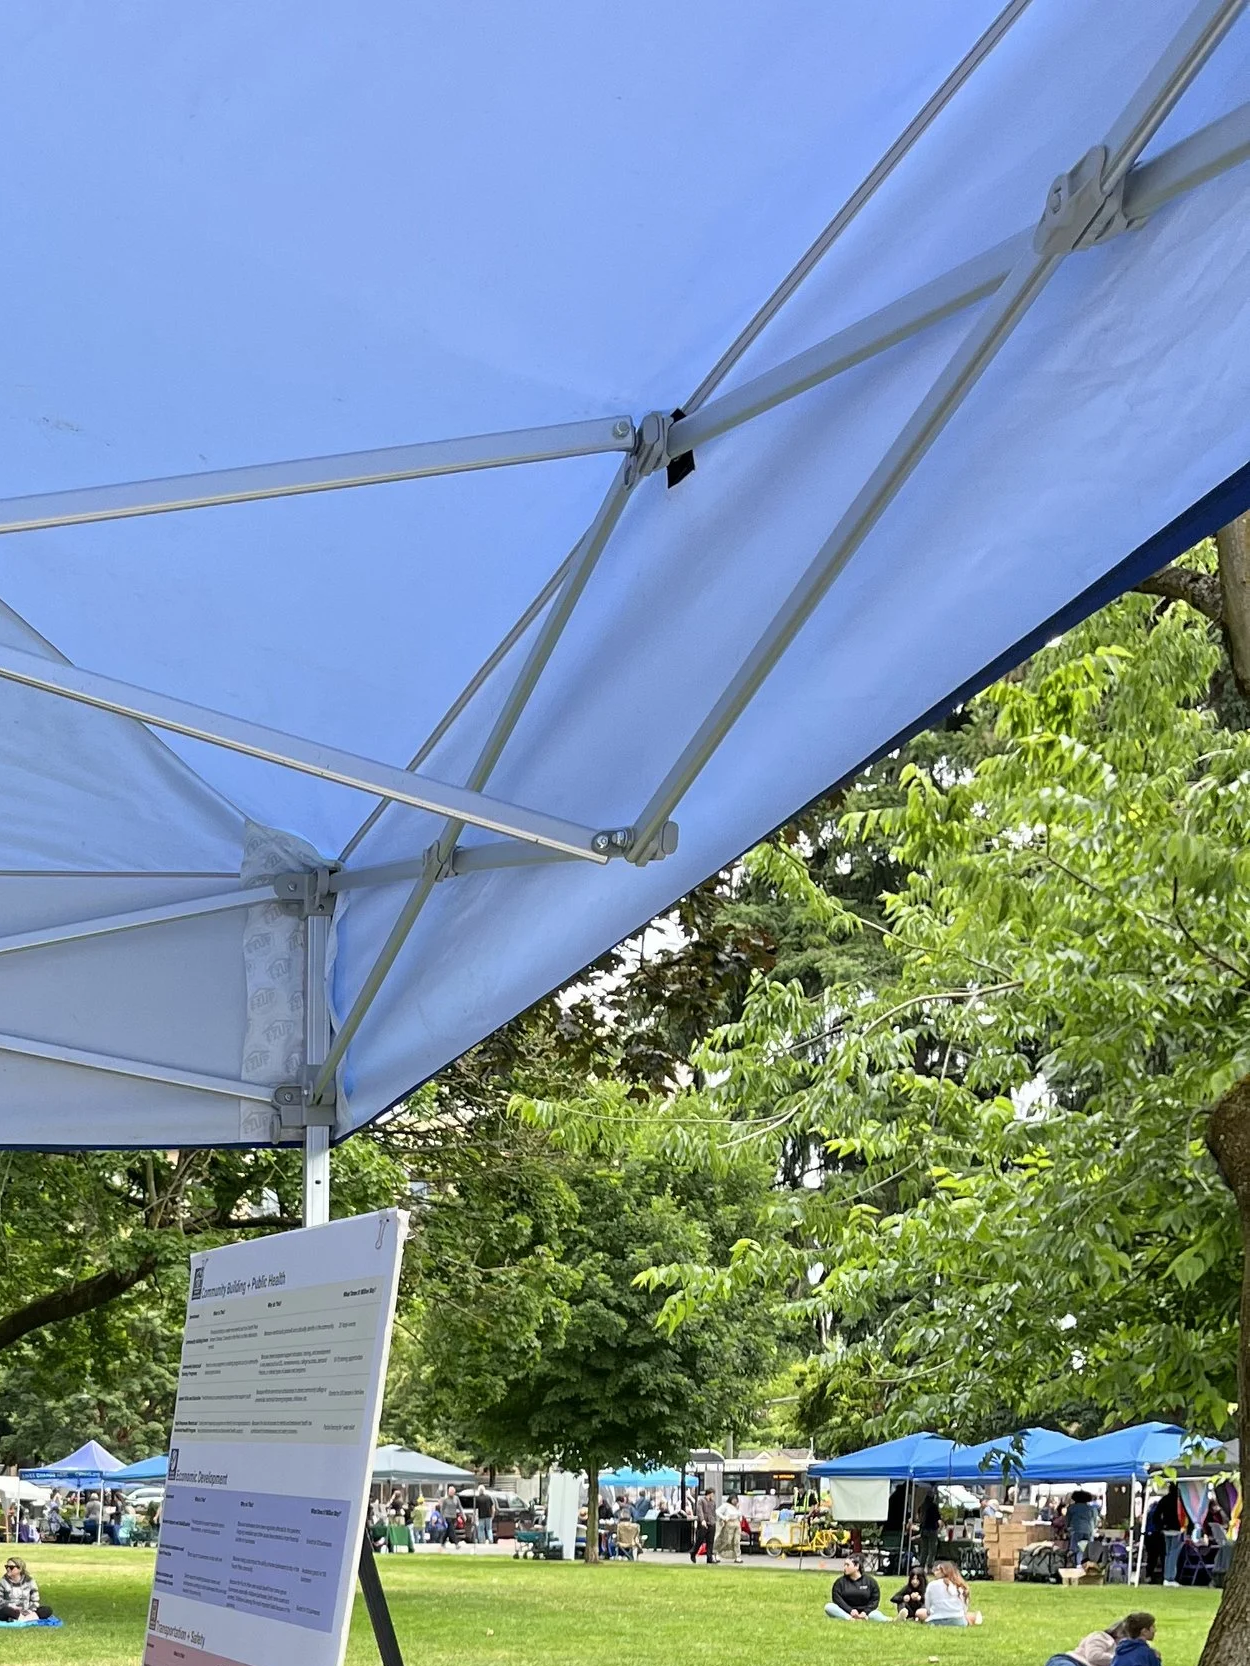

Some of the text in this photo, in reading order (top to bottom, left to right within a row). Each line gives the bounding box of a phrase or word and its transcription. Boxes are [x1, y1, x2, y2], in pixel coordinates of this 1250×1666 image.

[227, 1280, 246, 1295] Building
[251, 1276, 267, 1289] Public
[268, 1272, 286, 1287] Health
[176, 1470, 228, 1487] Economic Development
[191, 1633, 206, 1648] Safety
